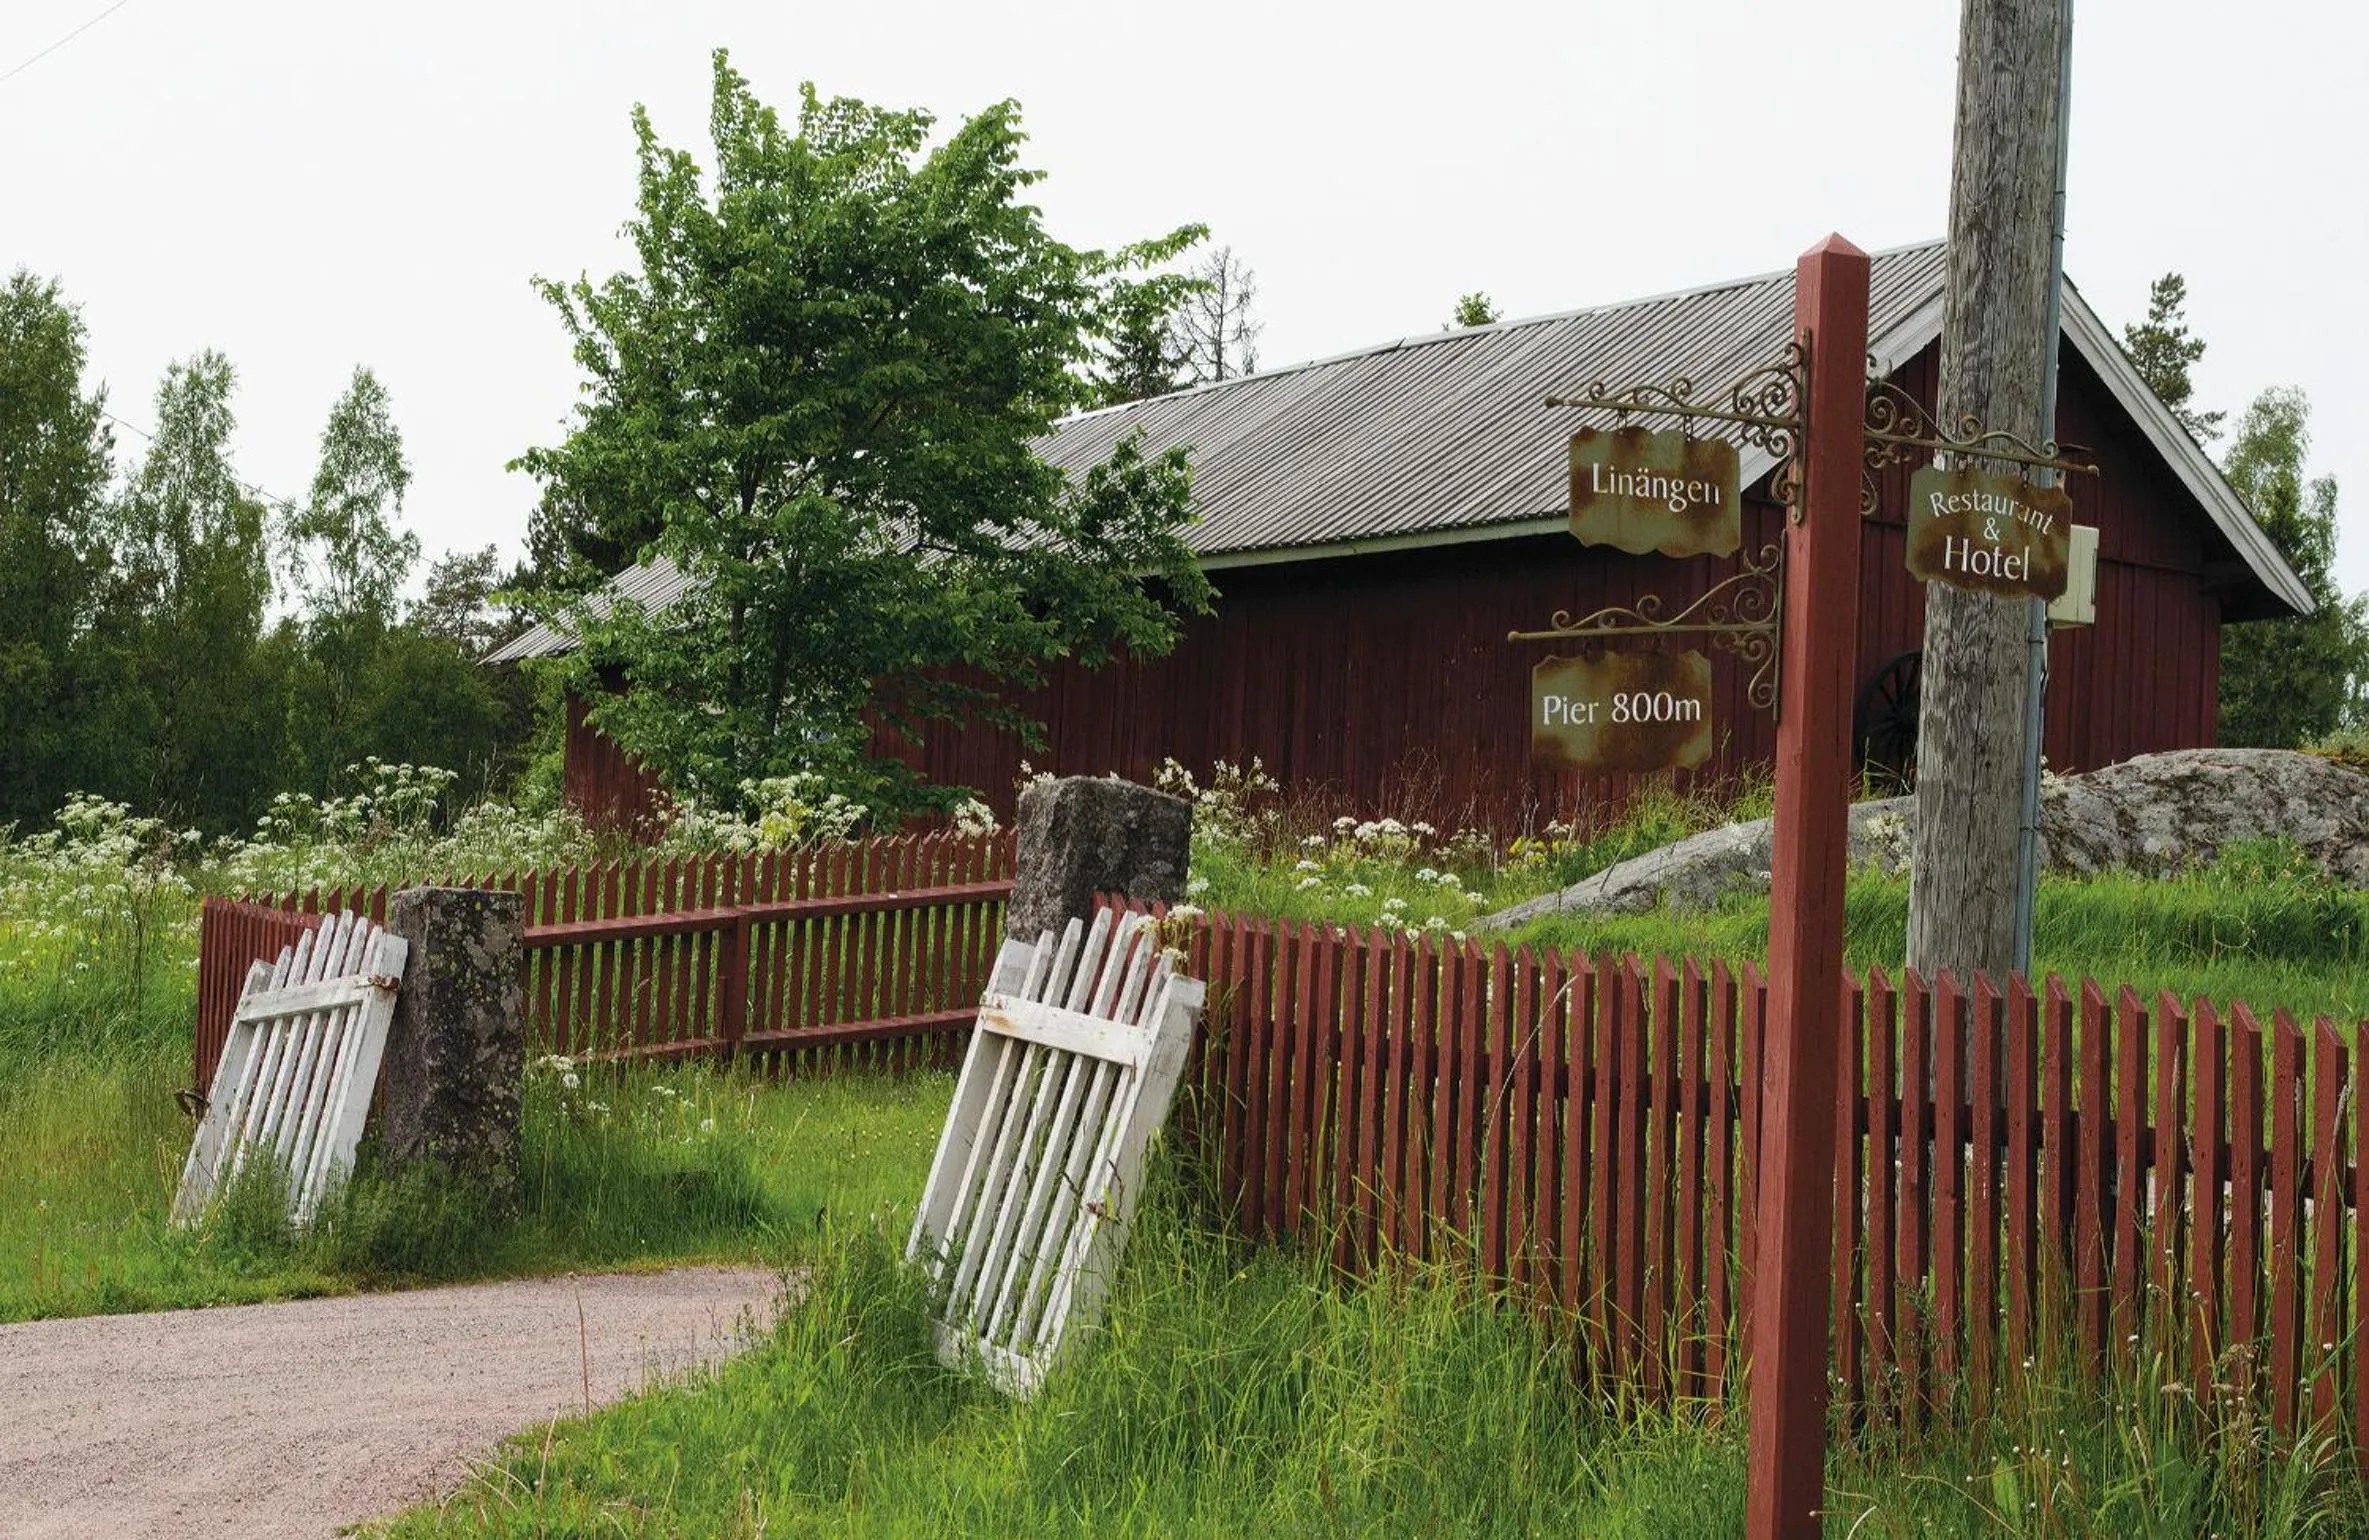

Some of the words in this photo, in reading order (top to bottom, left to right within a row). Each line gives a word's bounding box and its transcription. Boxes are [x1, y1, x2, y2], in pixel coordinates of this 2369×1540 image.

[1592, 462, 1720, 513] Linängen
[1929, 488, 2055, 535] Restaurant
[1983, 517, 2001, 541] &
[1944, 535, 2030, 582] Hotel
[1542, 695, 1600, 725] Pier
[1611, 691, 1701, 723] 800m
